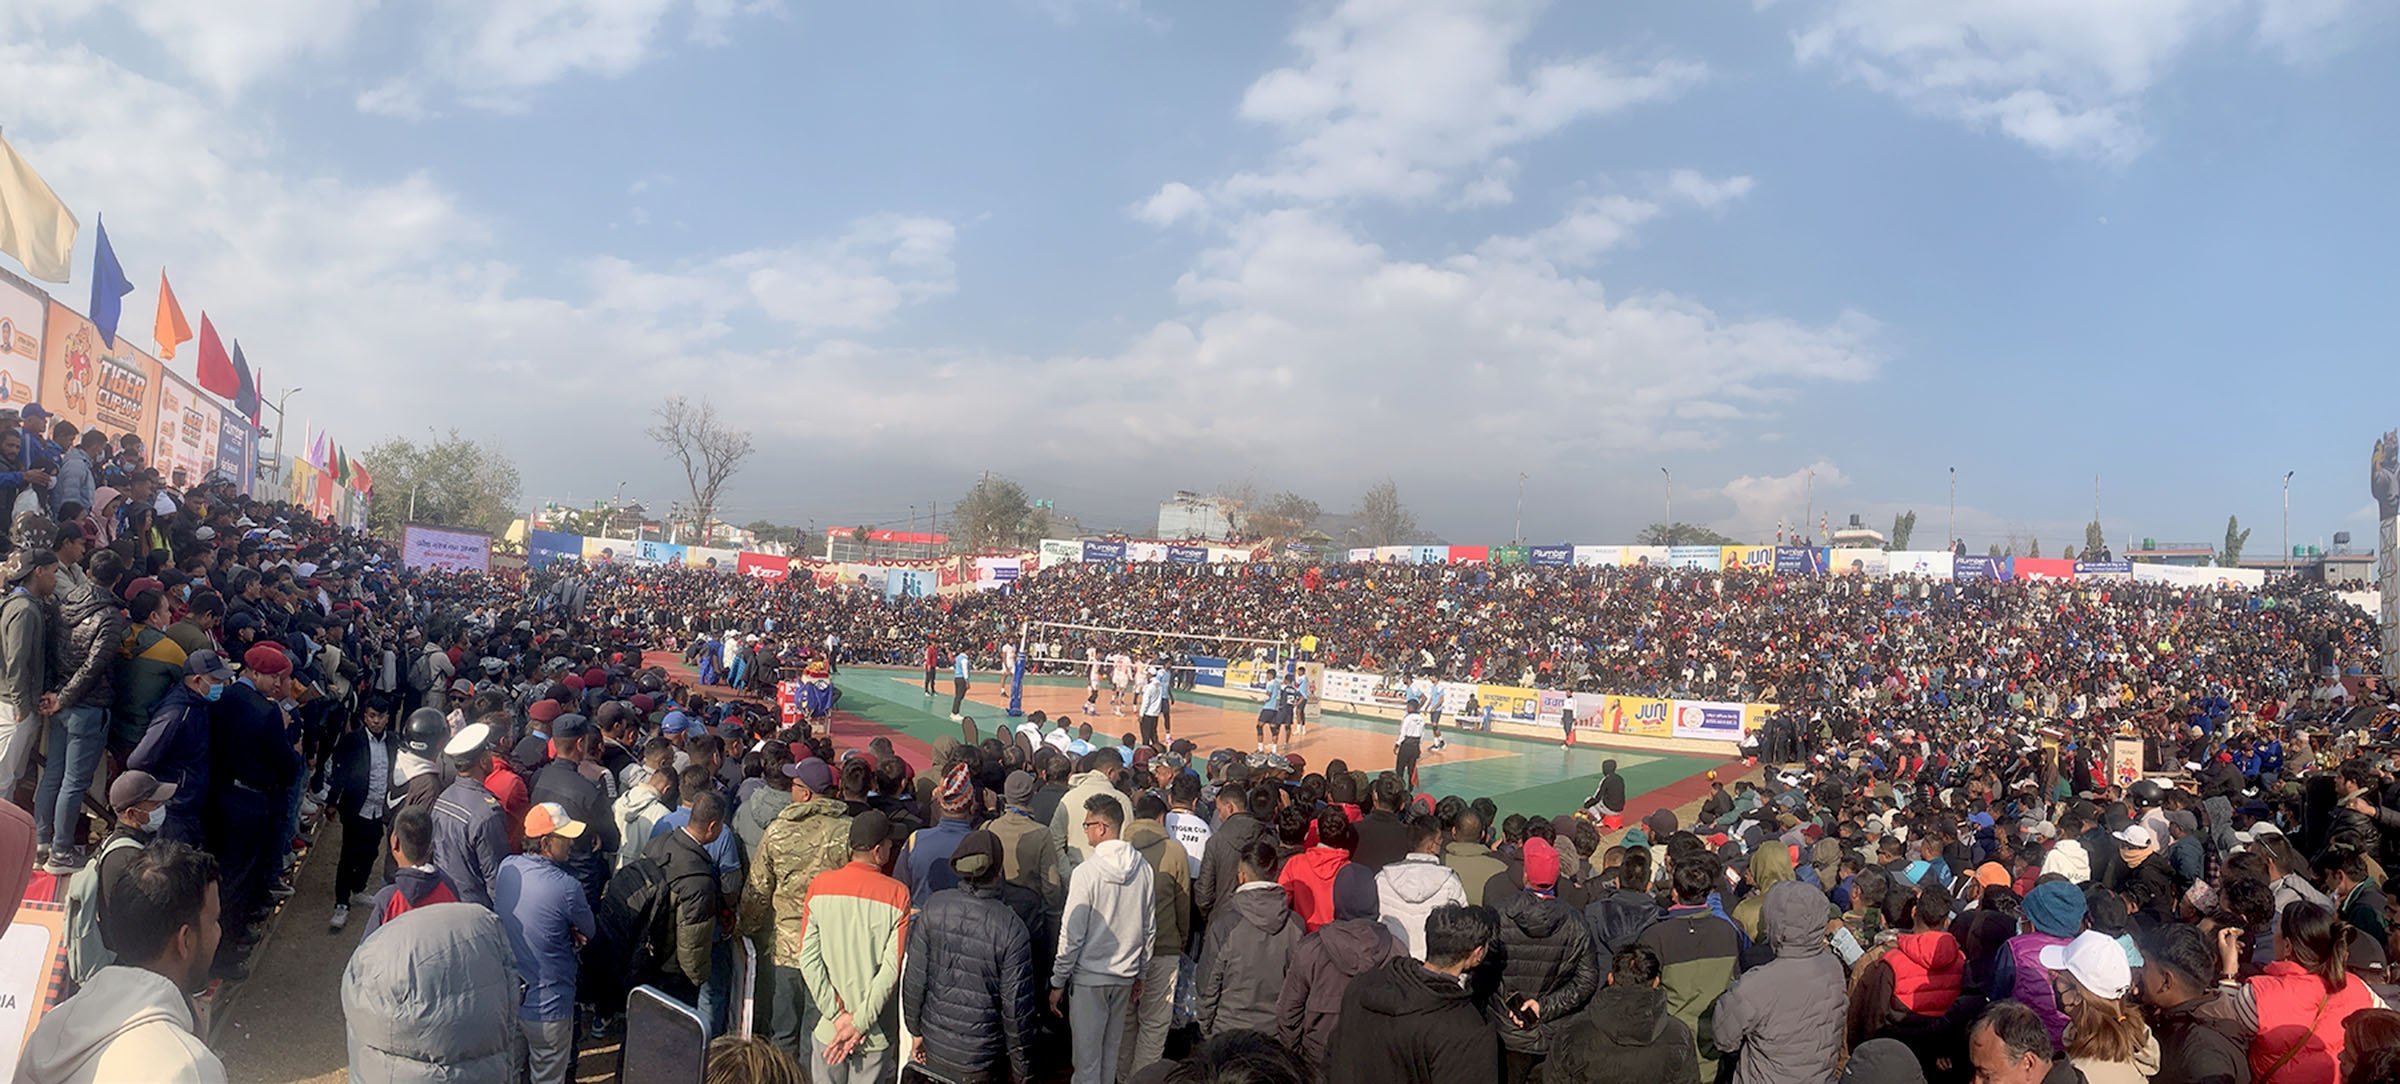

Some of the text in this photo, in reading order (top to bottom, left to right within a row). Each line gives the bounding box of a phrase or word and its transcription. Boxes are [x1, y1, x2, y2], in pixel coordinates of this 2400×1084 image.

[97, 359, 146, 402] TIGER
[1532, 548, 1568, 559] Plumber
[1635, 703, 1667, 721] JUNI
[1171, 824, 1193, 833] TIGER
